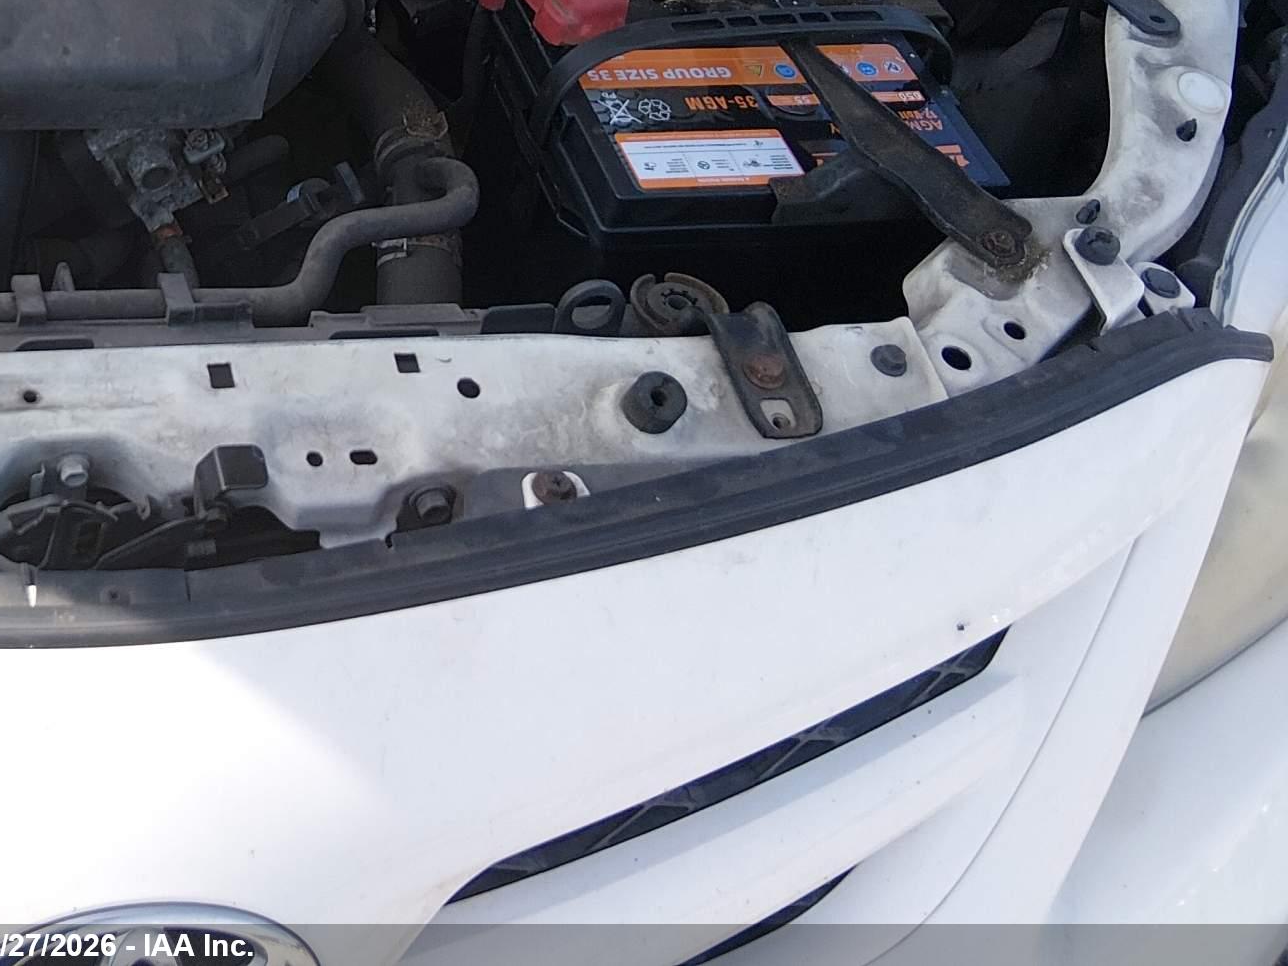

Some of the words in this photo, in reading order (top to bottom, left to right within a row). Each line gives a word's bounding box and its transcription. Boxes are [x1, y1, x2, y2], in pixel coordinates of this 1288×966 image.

[587, 70, 612, 81] 35
[614, 68, 659, 81] SIZE
[663, 65, 732, 79] GROUP
[684, 94, 760, 111] 35-AGM
[905, 119, 944, 131] AGM
